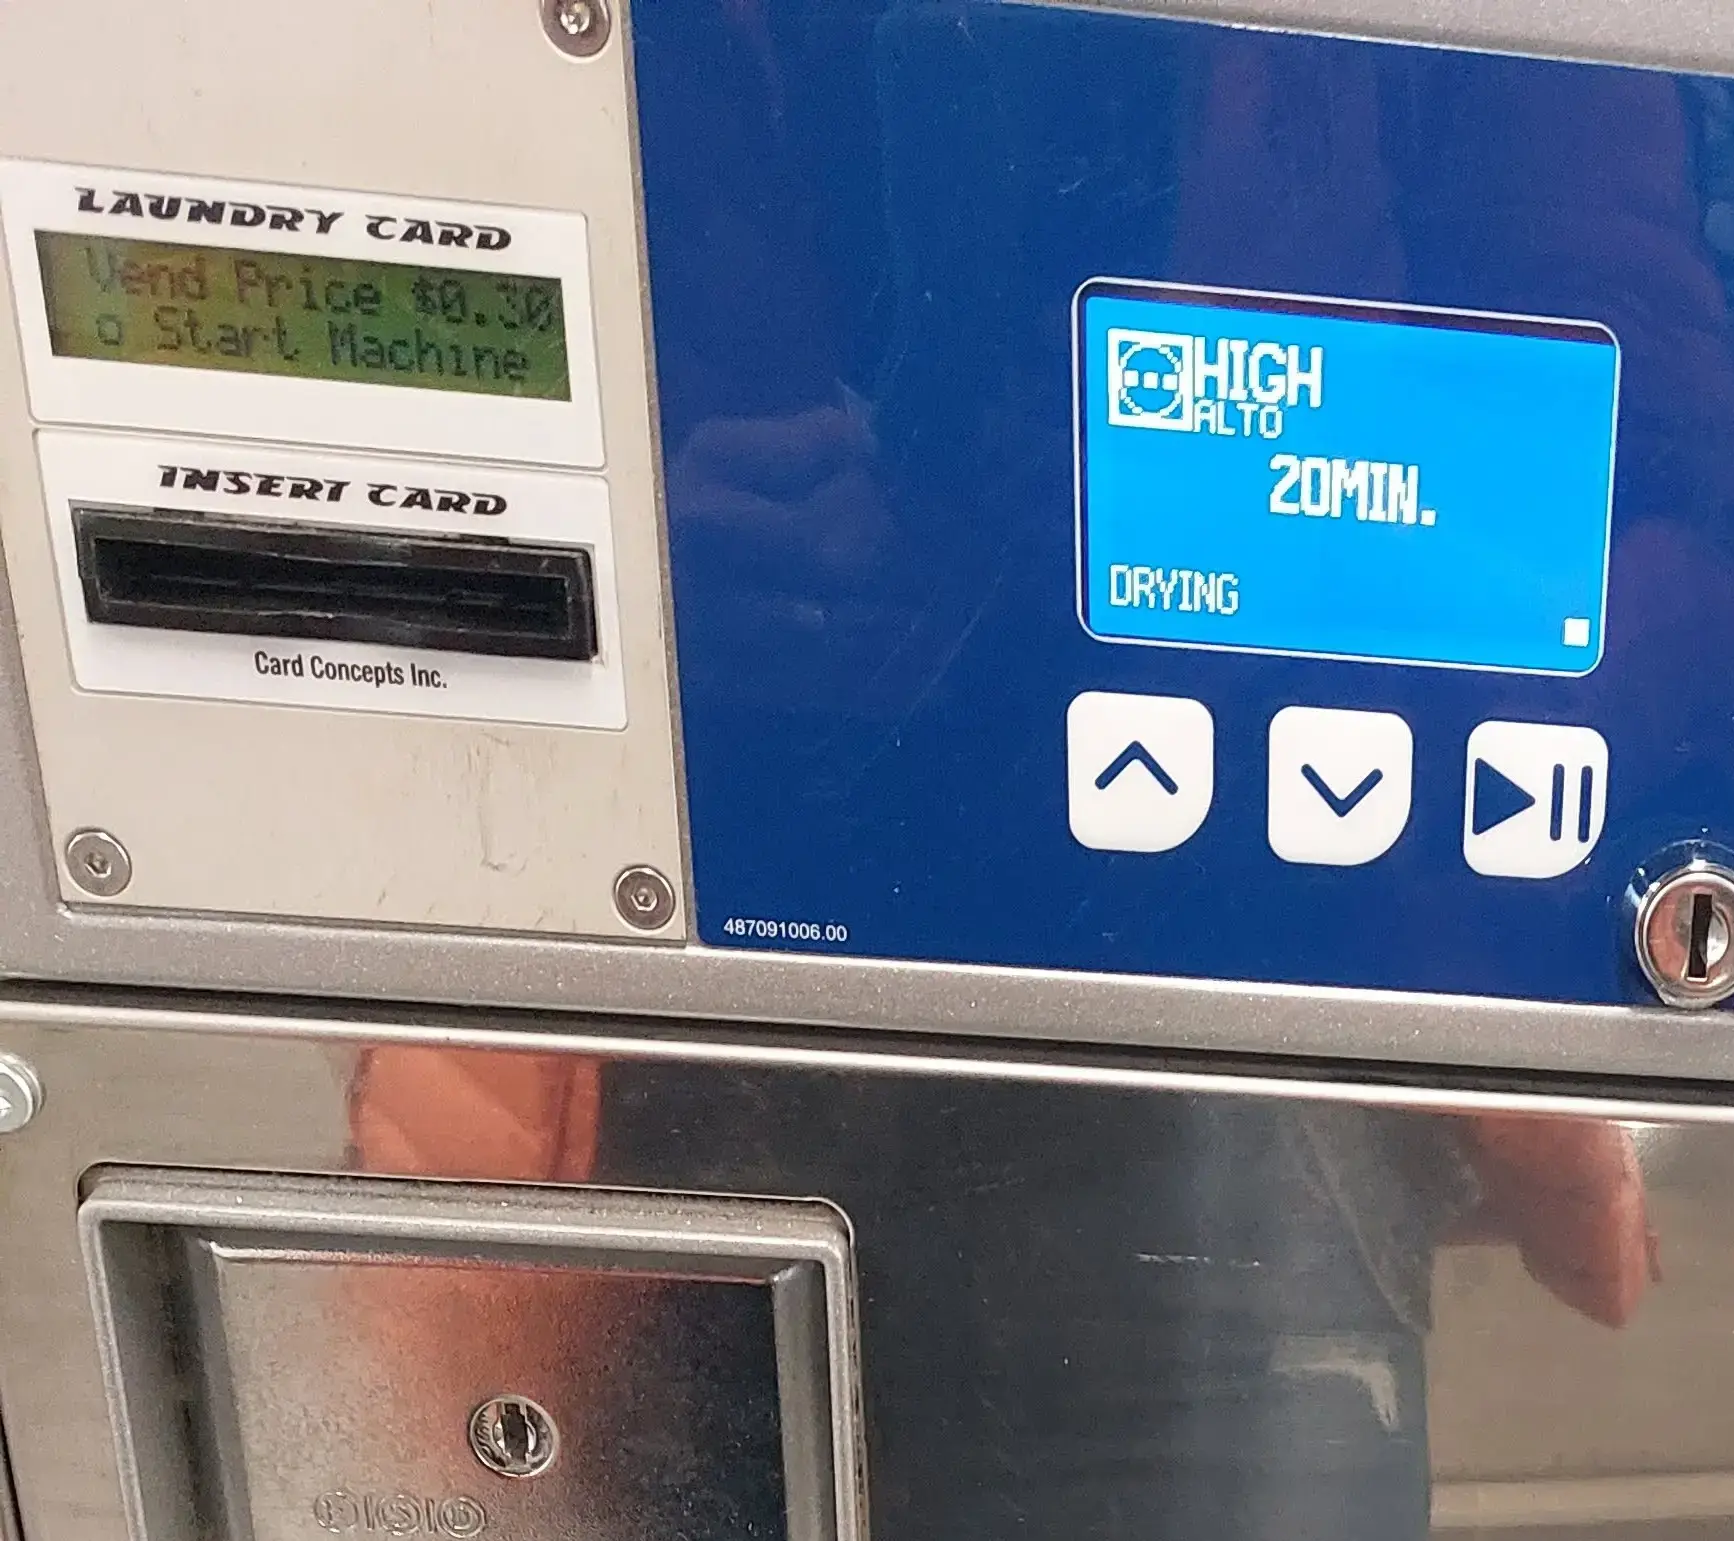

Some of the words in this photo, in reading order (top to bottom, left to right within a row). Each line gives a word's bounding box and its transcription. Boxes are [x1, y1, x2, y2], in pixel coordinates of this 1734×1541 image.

[74, 186, 344, 236] LAUNDRY
[364, 213, 513, 252] CARD
[85, 246, 208, 302] Vend
[233, 257, 383, 316] Price
[153, 306, 301, 362] Start
[326, 320, 531, 384] Machine
[1194, 336, 1324, 408] HIGH
[1192, 399, 1284, 439] ALTO
[157, 464, 351, 503] INSERT
[367, 482, 509, 517] CARD
[1109, 563, 1240, 615] DRYING
[253, 650, 303, 678] Card
[310, 655, 405, 689] Concepts
[410, 662, 448, 689] Inc.
[723, 917, 848, 942] 487091006.00
